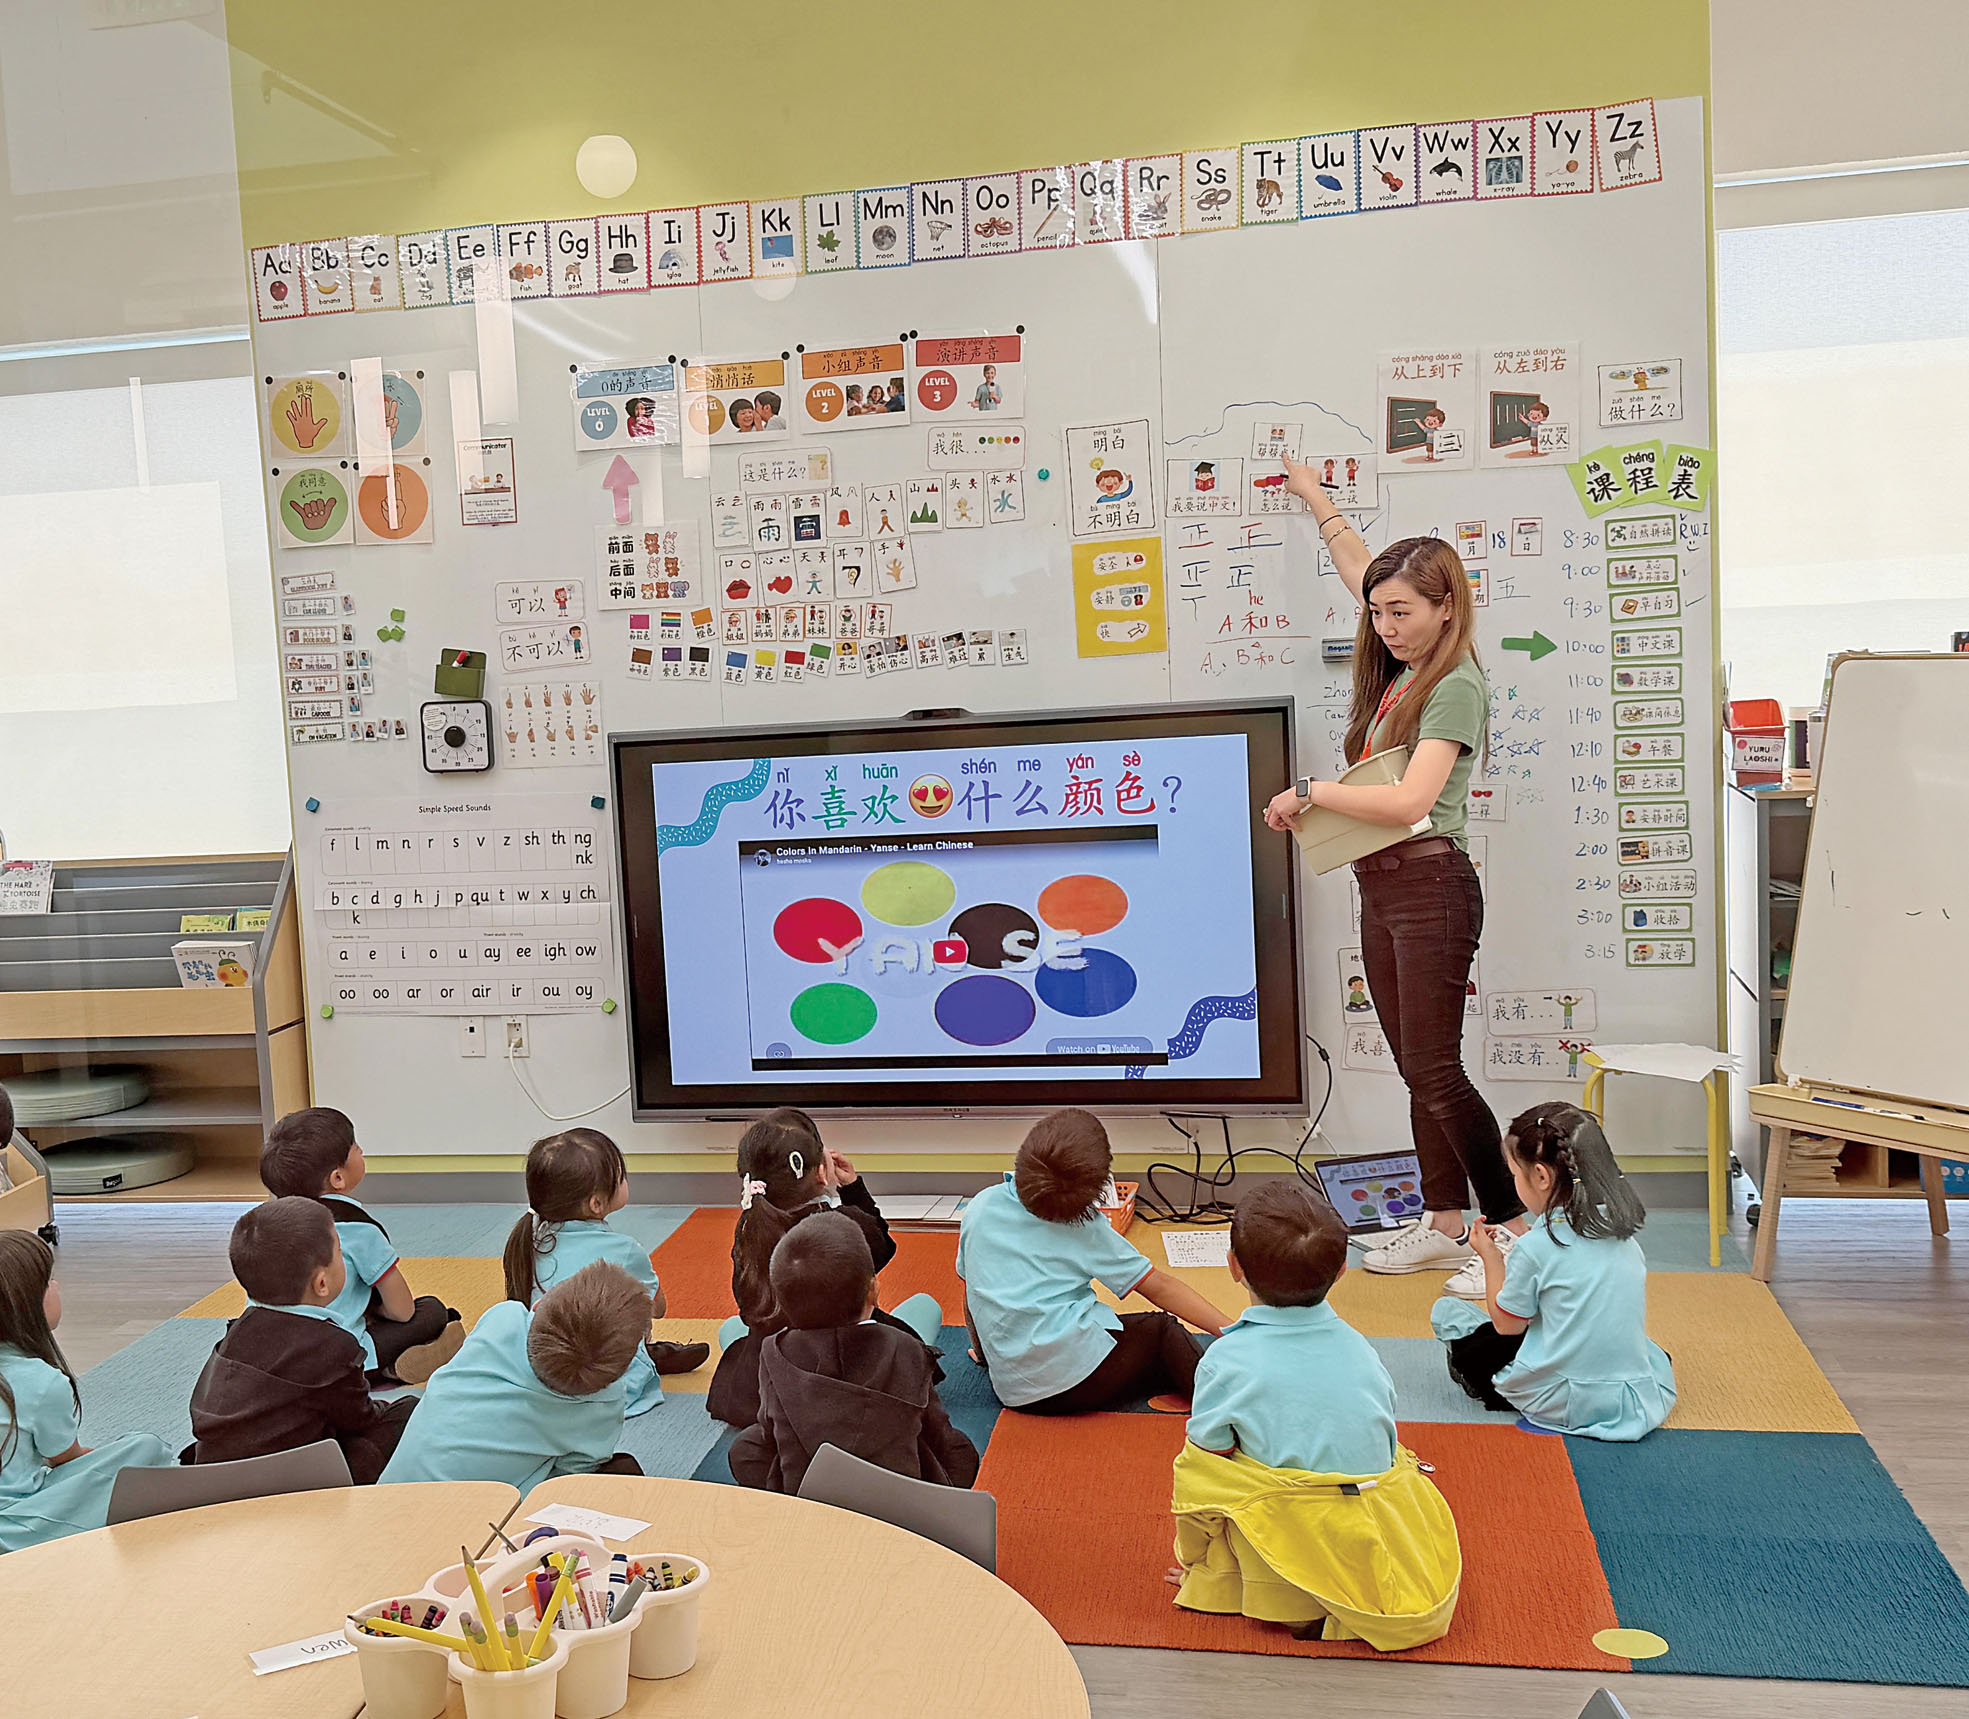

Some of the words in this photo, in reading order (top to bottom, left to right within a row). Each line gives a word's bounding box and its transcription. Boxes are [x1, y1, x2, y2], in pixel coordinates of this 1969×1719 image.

[1607, 113, 1645, 143] Zz
[1423, 130, 1469, 155] Ww
[1488, 126, 1521, 155] Xx
[1546, 119, 1582, 155] Yy
[1311, 143, 1345, 170] Uu
[1370, 137, 1405, 164] Vv
[1253, 150, 1287, 178] Tt
[1196, 159, 1226, 185] Ss
[1619, 171, 1644, 183] zebra
[1139, 167, 1170, 193] Rr
[1551, 180, 1575, 189] yo-yo
[1379, 192, 1398, 201] violin
[1435, 188, 1458, 197] whale
[1493, 185, 1516, 194] x-ray
[922, 190, 954, 217] Nn
[976, 185, 1010, 210] Oo
[1313, 199, 1347, 209] umbrella
[819, 201, 841, 229] Ll
[863, 196, 904, 221] Mm
[1261, 206, 1279, 217] tiger
[712, 212, 736, 243] Jj
[761, 208, 792, 234] Kk
[607, 225, 637, 250] Hh
[663, 220, 682, 245] Ii
[457, 235, 485, 259] Ee
[508, 230, 537, 257] Ff
[558, 229, 589, 258] Gg
[980, 239, 1009, 249] octopus
[361, 246, 389, 267] Cc
[713, 265, 739, 276] jellyfish
[520, 284, 533, 292] fish
[618, 277, 629, 285] hat
[272, 301, 289, 311] apple
[937, 347, 999, 363] 演讲声音
[822, 356, 883, 374] 小组声音
[1392, 362, 1463, 381] 从上到下
[1494, 356, 1567, 375] 从左到右
[925, 377, 950, 386] LEVEL
[812, 389, 836, 398] LEVEL
[933, 391, 941, 403] 3
[587, 407, 610, 417] LEVEL
[821, 402, 829, 414] 2
[1608, 403, 1675, 422] 做什么?
[595, 419, 603, 432] 0
[1093, 436, 1125, 453] 明白
[1623, 450, 1655, 466] chéng
[1678, 455, 1700, 470] biǎo
[744, 467, 806, 482] 这是什么?
[1586, 461, 1601, 474] kè
[990, 475, 1000, 484] 水
[910, 483, 919, 493] 山
[869, 492, 880, 502] 人
[753, 501, 765, 511] 雨
[1172, 500, 1237, 513] 我要说中文!
[1260, 502, 1292, 512] 怎么说
[1088, 509, 1140, 529] 不明白
[1492, 532, 1506, 549] 18
[1522, 541, 1531, 551] 日
[1563, 530, 1599, 548] 8:30
[607, 541, 634, 554] 前面
[878, 543, 889, 554] 手
[801, 552, 811, 562] 天
[609, 565, 635, 577] 后面
[1562, 564, 1600, 579] 9:00
[610, 587, 635, 599] 中间
[1493, 576, 1531, 600] 五
[1249, 590, 1264, 606] he
[1640, 599, 1673, 611] 早自习
[508, 598, 545, 615] 可以
[1563, 597, 1602, 618] 9:30
[1218, 614, 1232, 634] A
[1241, 612, 1268, 634] 和
[1276, 614, 1290, 630] B
[506, 642, 563, 663] 不可以
[1566, 640, 1605, 654] 10:00
[1638, 640, 1675, 652] 中文课
[1569, 674, 1603, 688] 11:00
[1637, 676, 1674, 687] 数学课
[1569, 707, 1601, 724] 11:40
[1571, 741, 1601, 758] 12:10
[1648, 744, 1675, 757] 午餐
[862, 763, 899, 780] huān
[961, 757, 997, 774] shén
[1017, 758, 1042, 773] me
[1066, 753, 1095, 773] yán
[1122, 751, 1142, 768] sè
[1572, 776, 1607, 793] 12:40
[1640, 778, 1678, 789] 艺术课
[419, 805, 441, 813] Simple
[443, 805, 463, 813] Speed
[466, 804, 491, 812] Sounds
[764, 784, 907, 832] 你喜欢
[957, 771, 1182, 824] 什么颜色?
[1575, 806, 1609, 824] 1:30
[1640, 813, 1686, 823] 安静时间
[524, 832, 541, 846] sh
[552, 831, 566, 845] th
[574, 834, 592, 847] ng
[776, 847, 806, 857] Colors
[808, 846, 817, 855] in
[819, 844, 862, 854] Mandarin
[870, 844, 899, 853] Yanse
[907, 842, 933, 851] Learn
[935, 841, 974, 850] Chinese
[1576, 843, 1607, 856] 2:00
[576, 851, 593, 864] nk
[1576, 876, 1610, 890] 2:30
[1644, 880, 1695, 892] 小组活动
[471, 891, 489, 906] qu
[580, 886, 597, 900] ch
[1577, 909, 1612, 924] 3:00
[1654, 915, 1680, 925] 收拾
[484, 947, 501, 961] ay
[516, 947, 531, 957] ee
[544, 943, 566, 960] igh
[575, 945, 596, 956] ow
[1585, 944, 1616, 959] 3:15
[1658, 948, 1686, 960] 放学
[339, 989, 356, 1000] oo
[373, 988, 389, 999] oo
[407, 987, 421, 999] ar
[440, 987, 454, 998] or
[472, 984, 491, 998] air
[512, 984, 522, 997] ir
[542, 986, 561, 997] ou
[576, 984, 593, 1000] oy
[1057, 1045, 1083, 1053] Watch
[1112, 1044, 1140, 1053] YouTube
[301, 1640, 348, 1656] Wen
